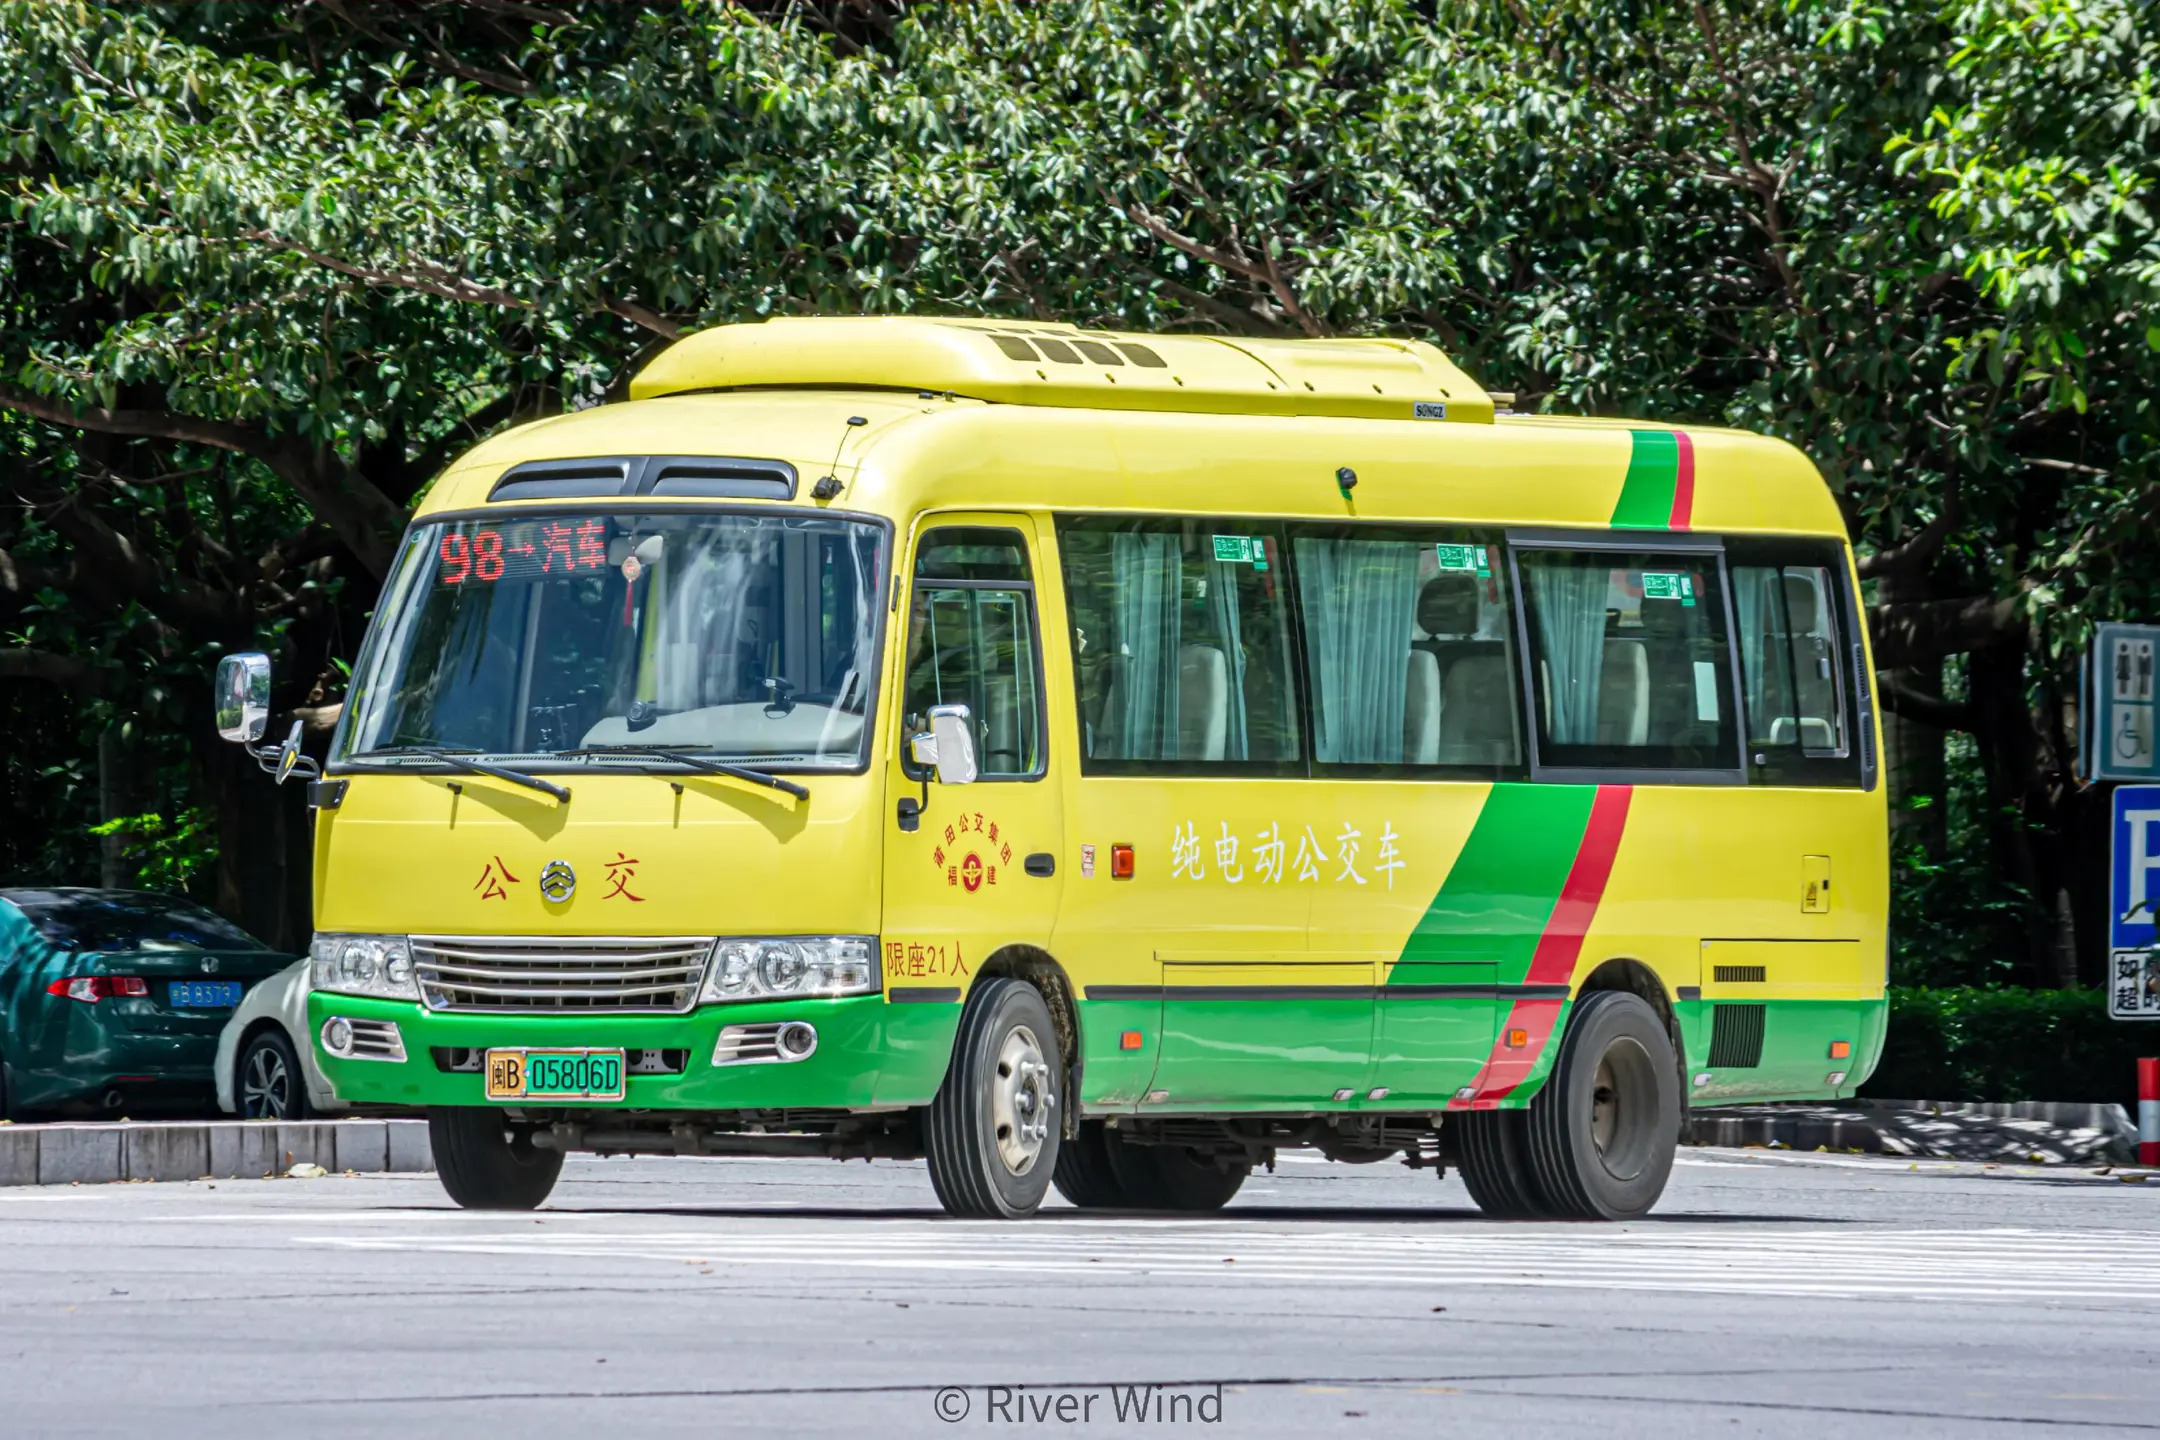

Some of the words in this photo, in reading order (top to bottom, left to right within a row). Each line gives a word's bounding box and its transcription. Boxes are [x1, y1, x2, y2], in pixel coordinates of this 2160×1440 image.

[1416, 404, 1444, 418] SONGZ
[440, 530, 504, 584] 98
[542, 519, 606, 573] 汽车
[1171, 820, 1407, 891] 纯电动公交车
[886, 941, 969, 977] 限座21人
